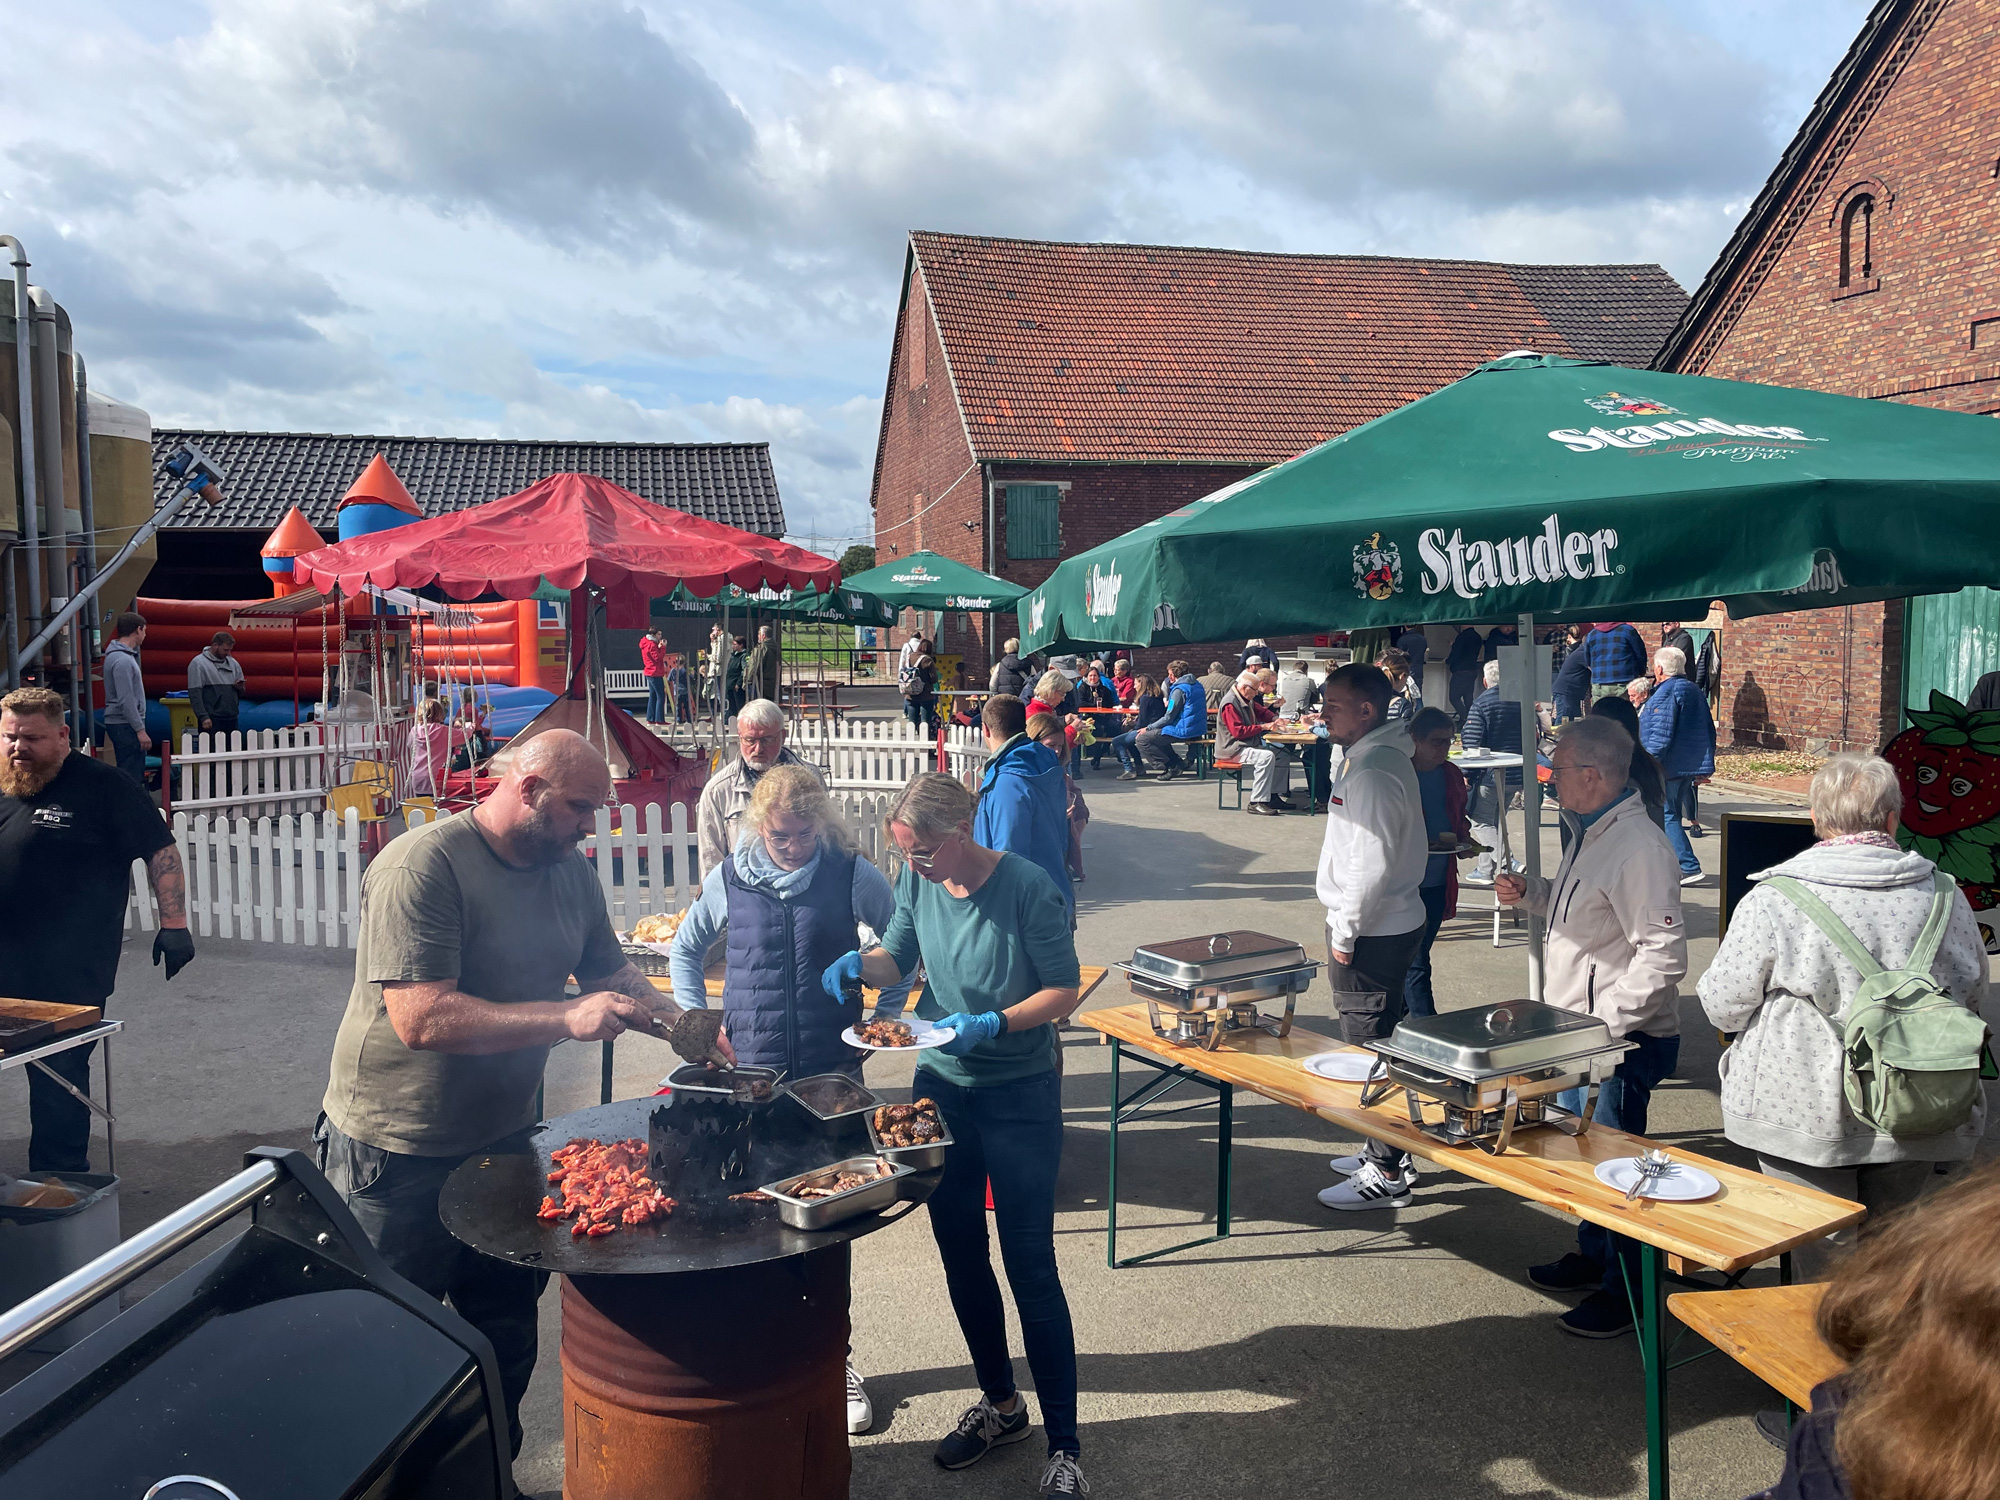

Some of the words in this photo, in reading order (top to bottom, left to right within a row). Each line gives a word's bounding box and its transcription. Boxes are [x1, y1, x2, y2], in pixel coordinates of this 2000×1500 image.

[1548, 417, 1815, 453] Stauder
[1682, 446, 1799, 460] Premium
[1417, 513, 1618, 599] Stauder
[891, 574, 941, 582] Stauder
[956, 595, 991, 609] Stauder
